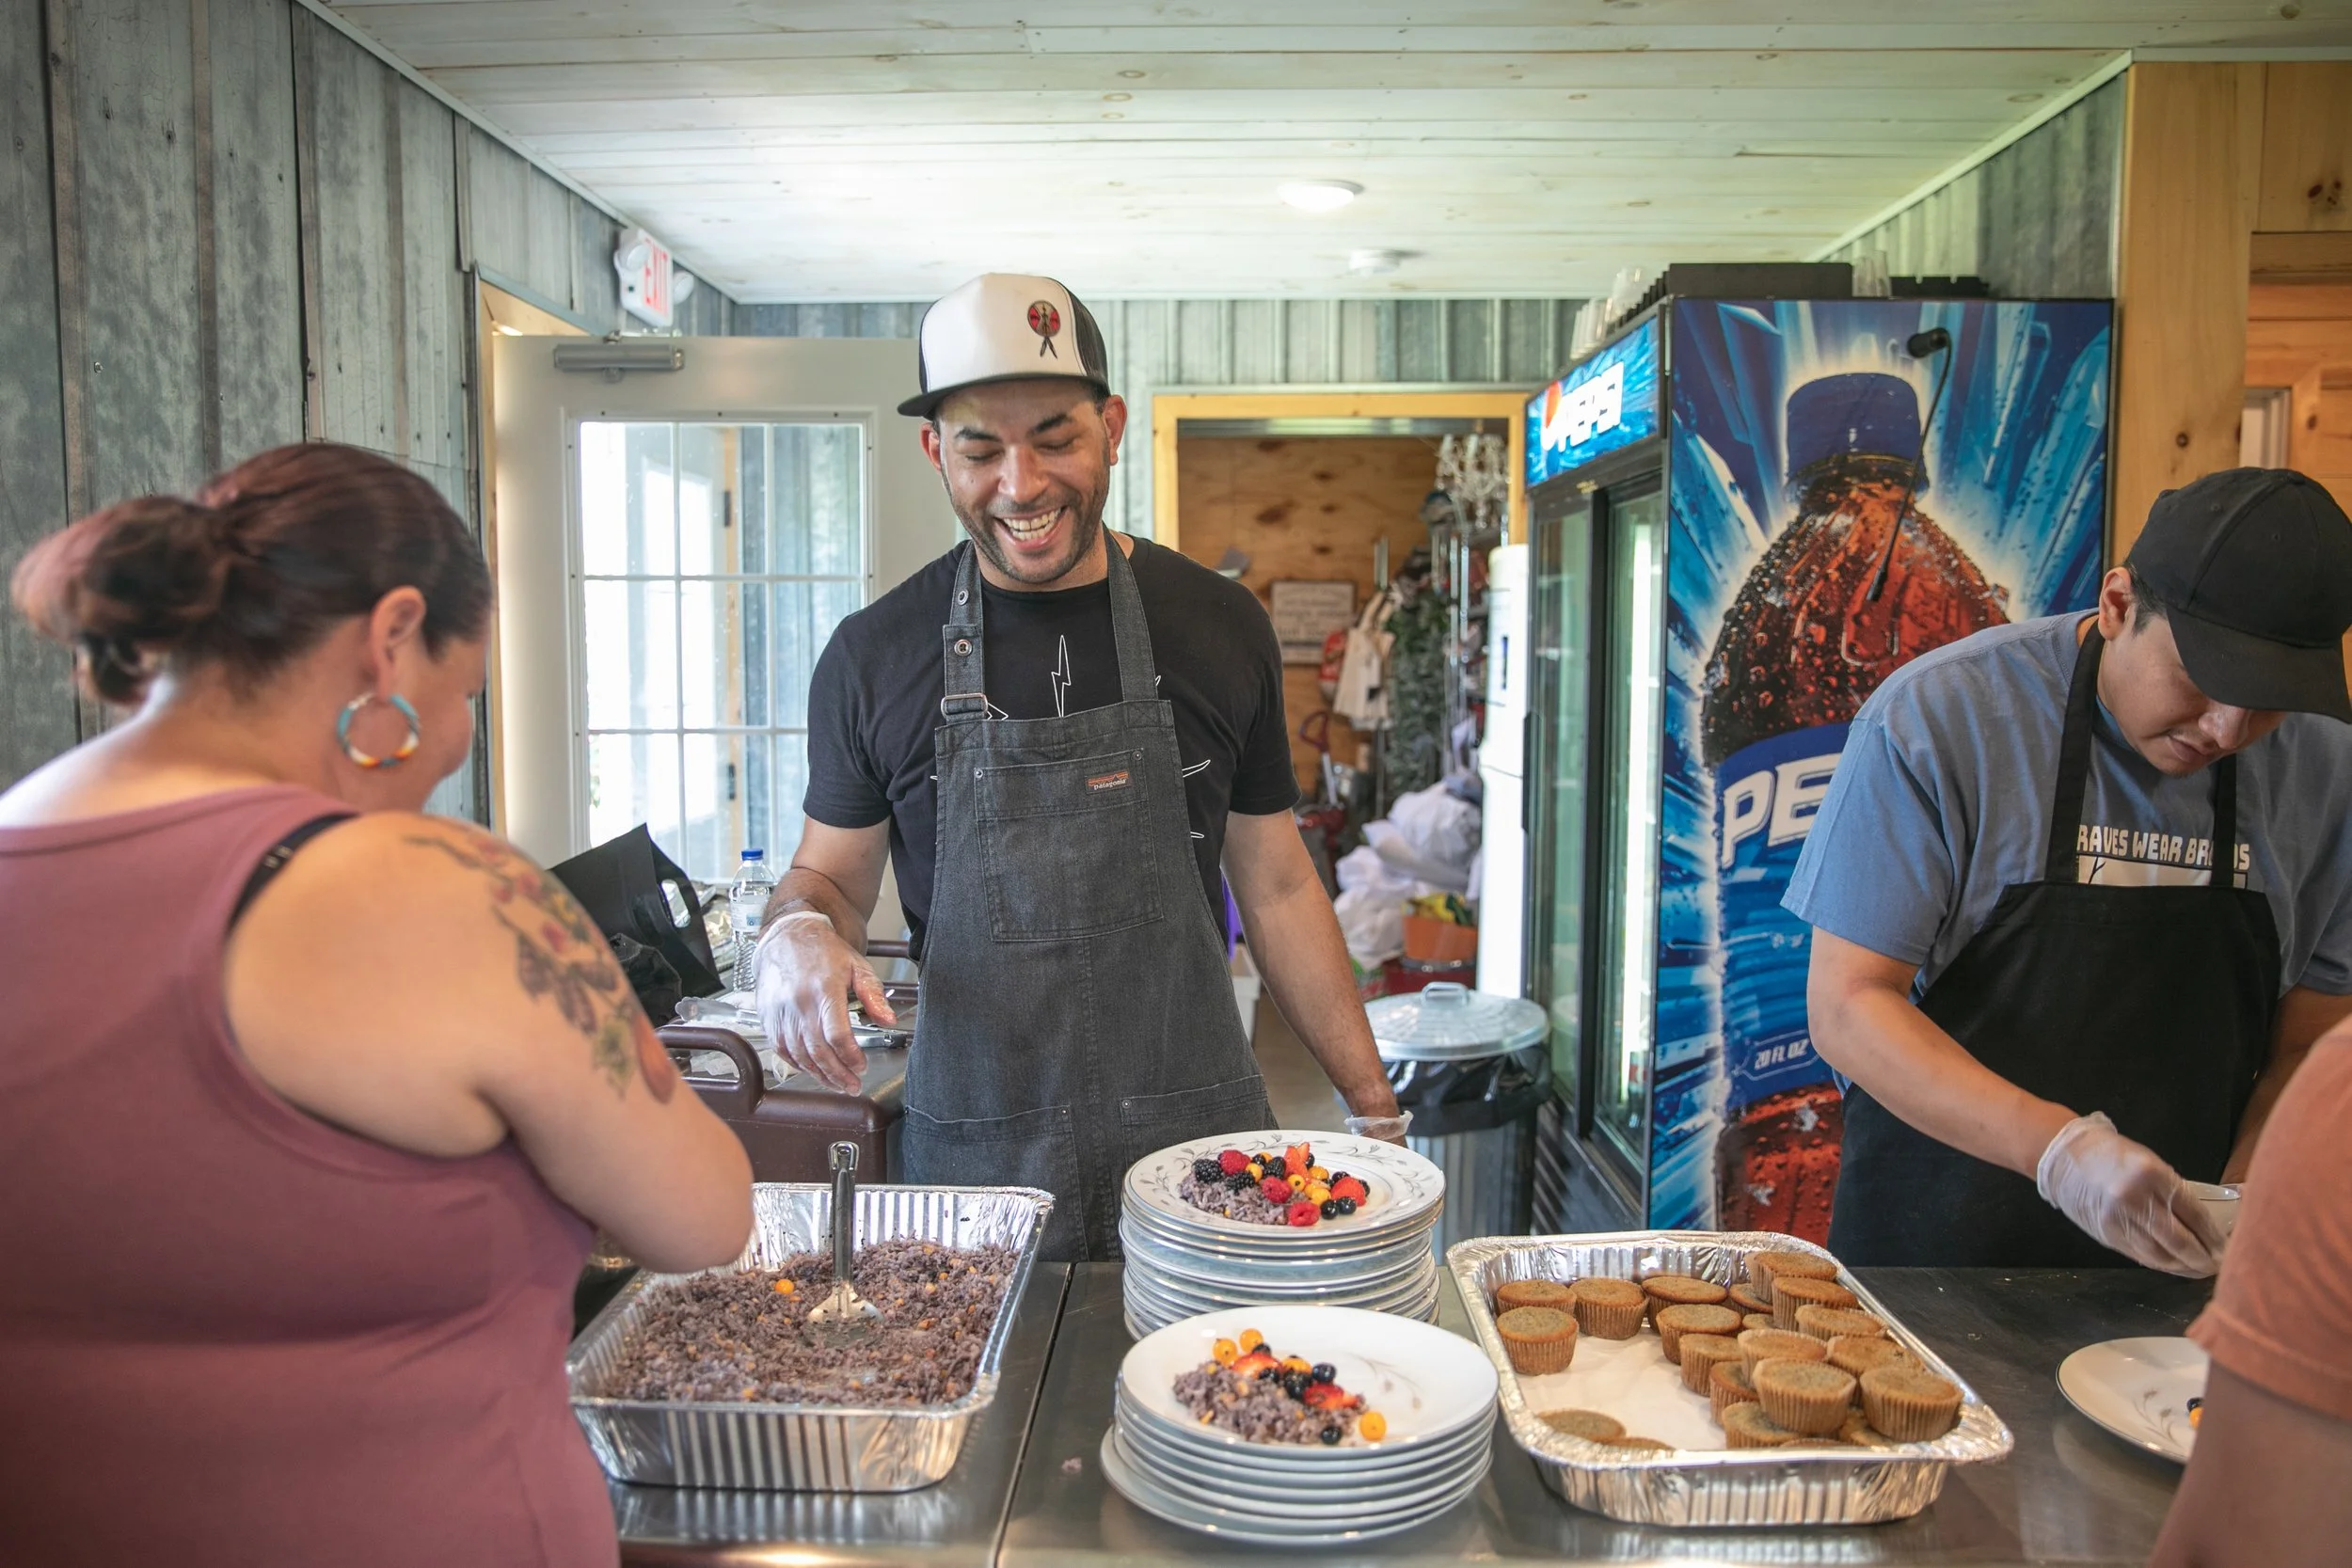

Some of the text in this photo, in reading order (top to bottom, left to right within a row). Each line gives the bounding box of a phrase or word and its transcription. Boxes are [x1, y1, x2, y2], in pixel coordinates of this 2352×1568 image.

[1557, 361, 1625, 453] PEPSI
[1093, 778, 1126, 790] patagonia
[1722, 752, 1843, 869] PE
[2075, 824, 2129, 856] RAVES
[2132, 832, 2183, 863] WEAR
[1754, 1037, 1810, 1070] 20 FL OZ
